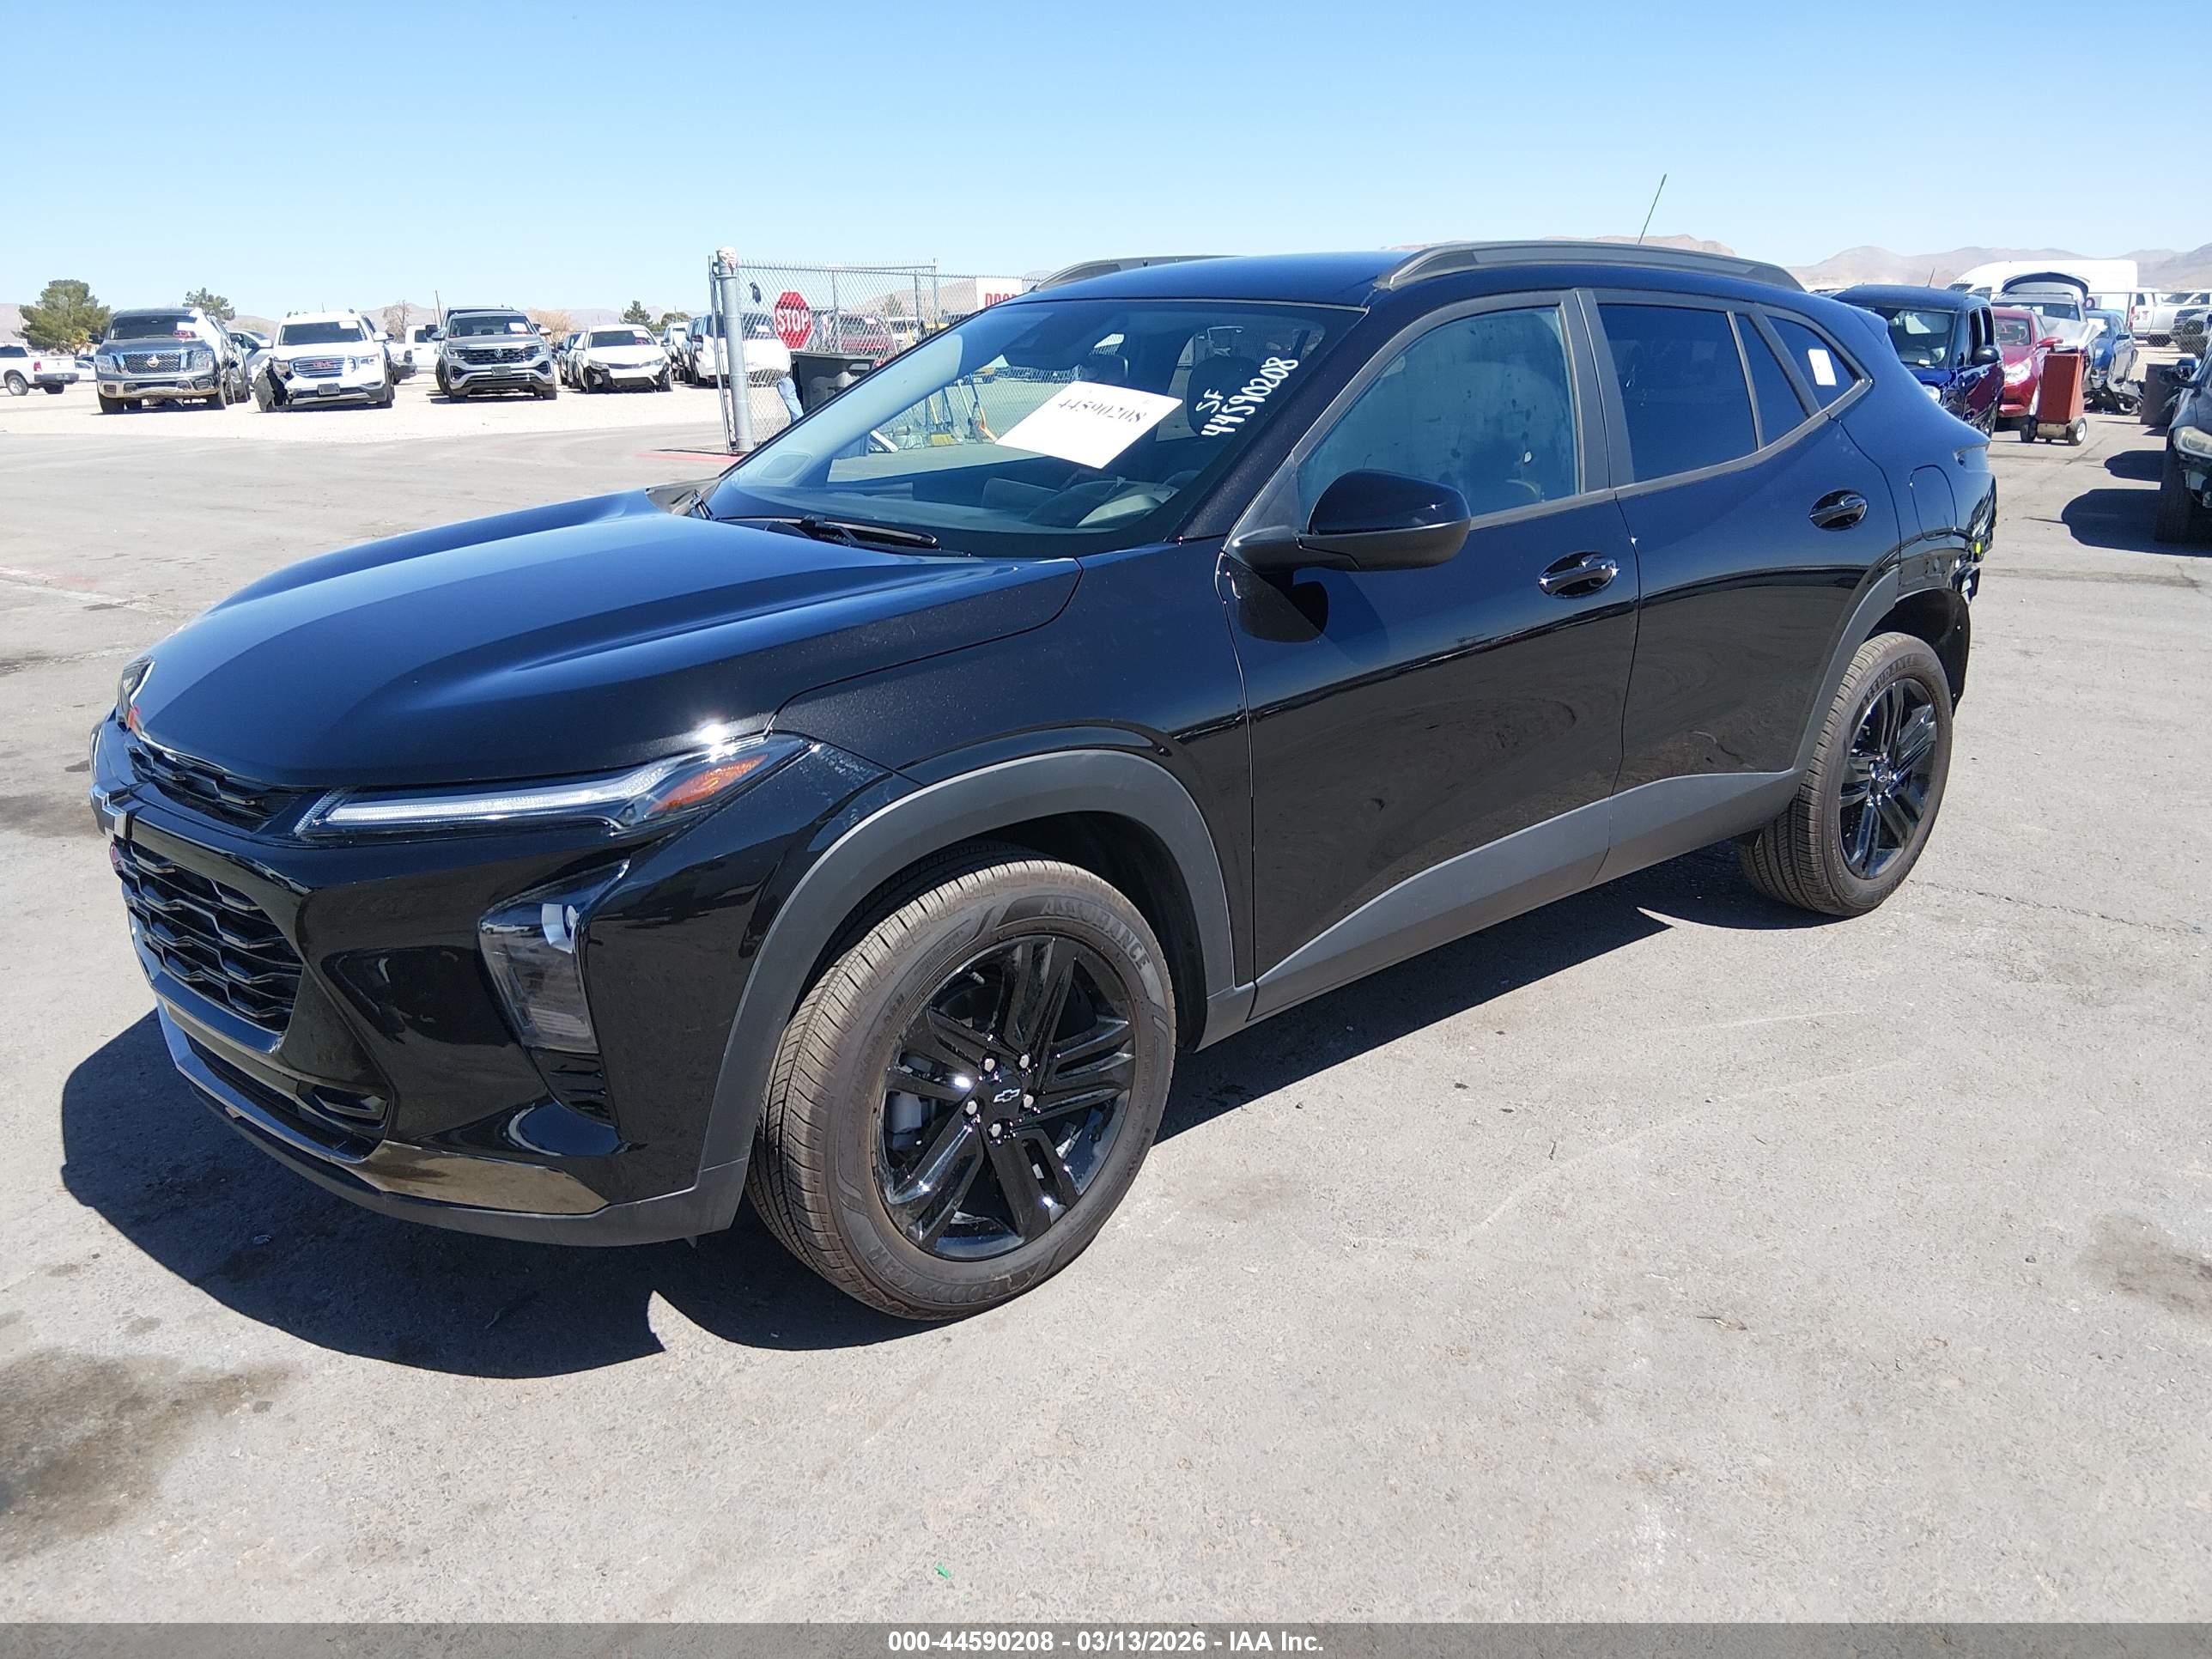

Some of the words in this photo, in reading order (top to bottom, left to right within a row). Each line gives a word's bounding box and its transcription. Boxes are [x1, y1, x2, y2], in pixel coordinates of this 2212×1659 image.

[776, 309, 809, 332] STOP
[1195, 388, 1224, 413] SF
[1200, 356, 1298, 435] 44590208
[1040, 897, 1151, 972] ASSURANCE
